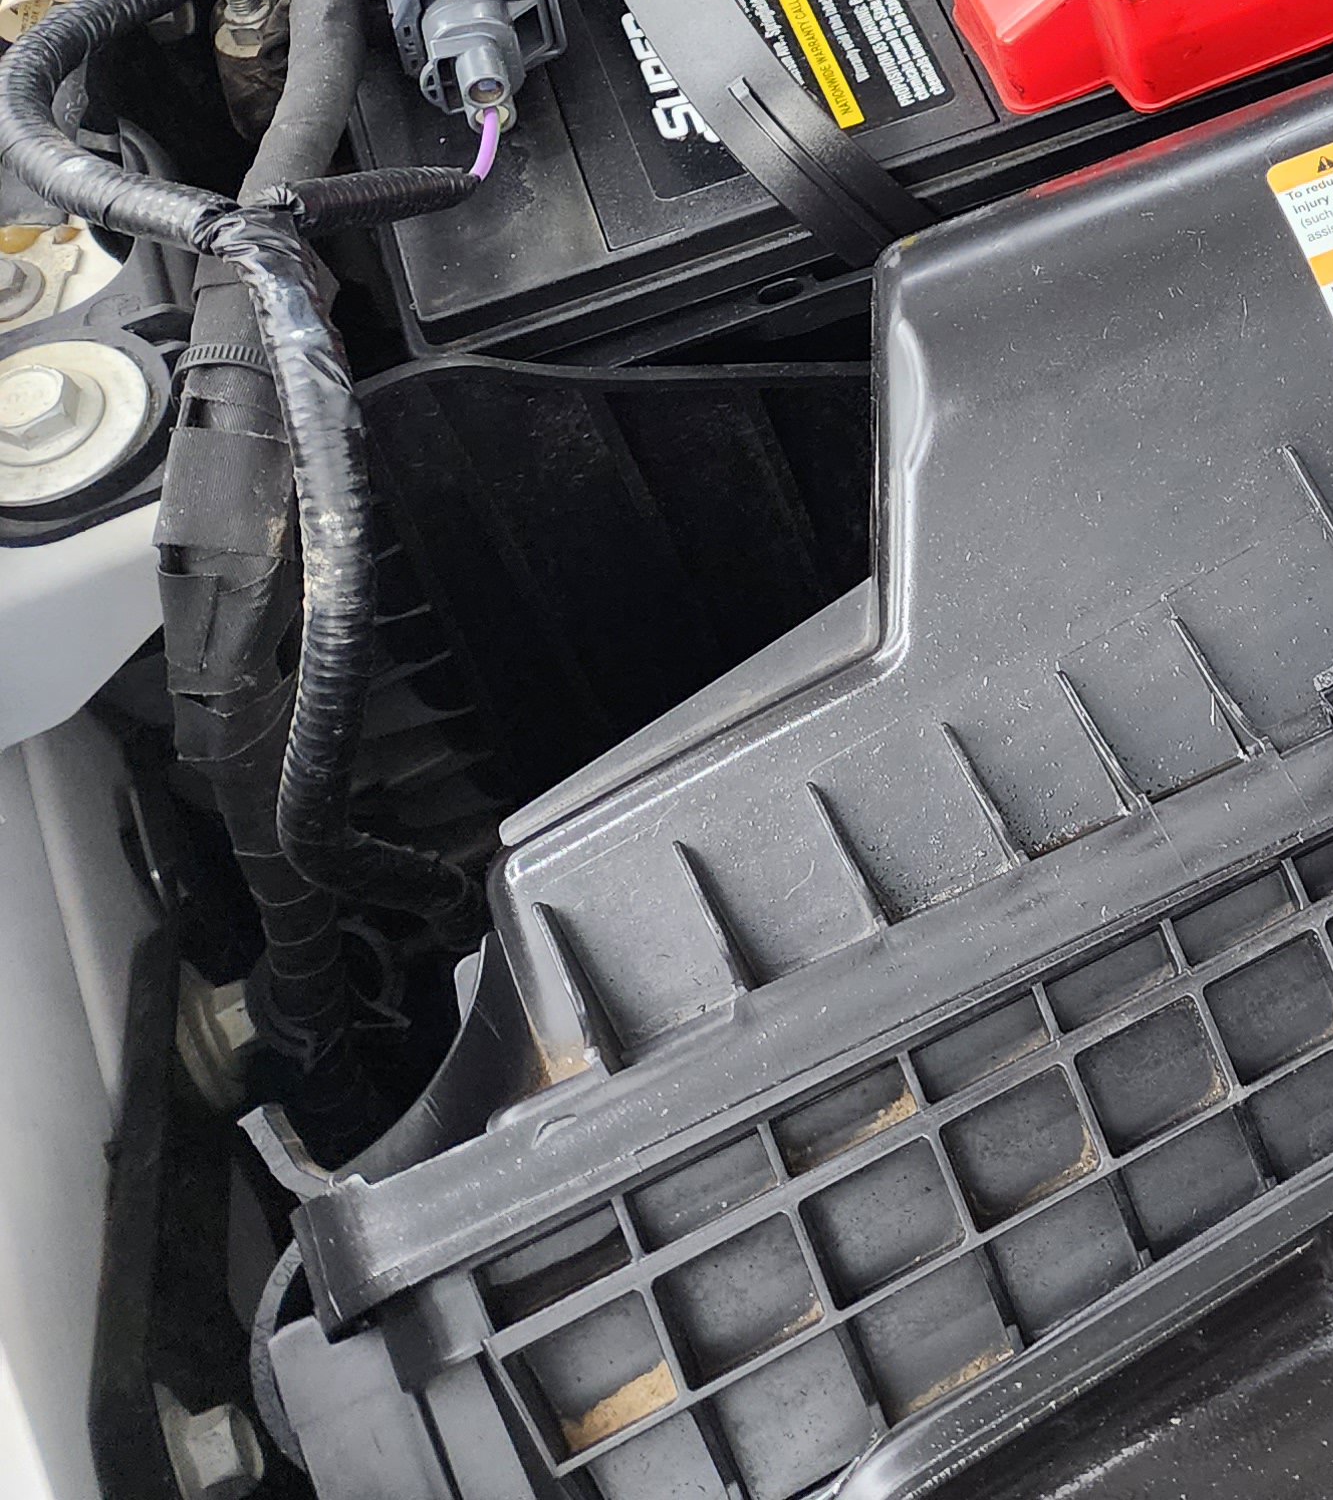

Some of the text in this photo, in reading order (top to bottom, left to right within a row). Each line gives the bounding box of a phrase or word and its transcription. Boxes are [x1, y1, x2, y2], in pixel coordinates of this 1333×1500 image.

[797, 19, 828, 64] WARRANTY
[819, 63, 853, 115] NATIONWIDE
[1286, 190, 1303, 200] To
[1292, 194, 1329, 214] injury
[1299, 208, 1333, 229] (such
